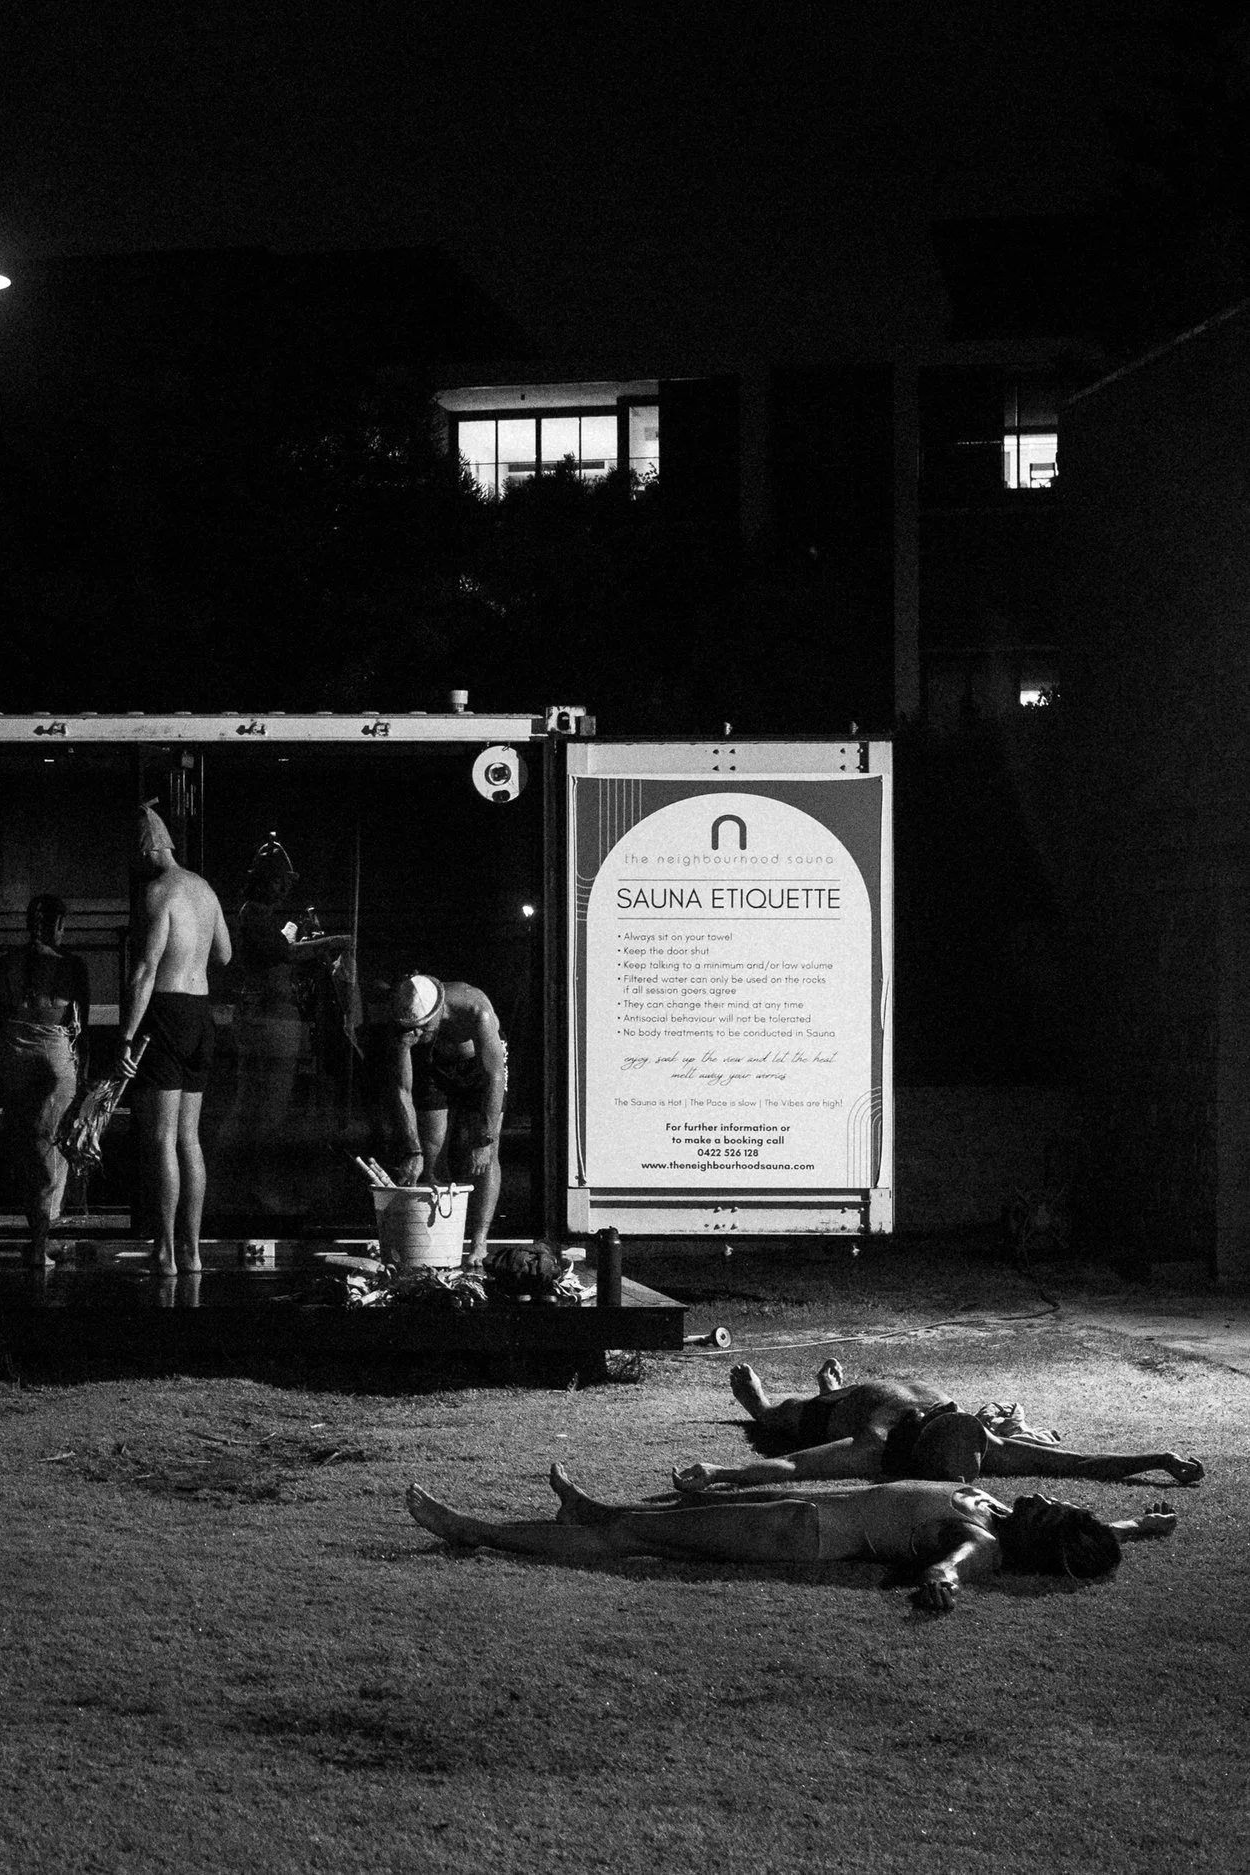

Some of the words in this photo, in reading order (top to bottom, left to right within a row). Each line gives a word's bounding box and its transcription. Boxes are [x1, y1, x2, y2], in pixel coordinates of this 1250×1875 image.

[624, 854, 648, 864] the
[656, 854, 779, 867] neighbourhood
[786, 855, 833, 865] sauna
[616, 888, 702, 909] SAUNA
[711, 888, 840, 909] ETIQUETTE
[623, 932, 655, 943] Always
[657, 933, 668, 942] sit
[670, 934, 682, 942] on
[685, 934, 704, 944] your
[706, 932, 732, 942] towel
[623, 947, 646, 956] Keep
[648, 946, 664, 956] the
[666, 946, 687, 956] door
[690, 946, 709, 956] shut
[623, 961, 646, 970] Keep
[649, 961, 679, 971] talking
[682, 962, 692, 970] to
[694, 962, 700, 970] a
[703, 962, 744, 970] minimum
[746, 961, 779, 971] and/or
[781, 960, 798, 970] low
[800, 961, 833, 970] volume
[623, 975, 658, 986] Filtered
[661, 976, 687, 984] water
[689, 976, 707, 984] can
[709, 976, 728, 985] only
[730, 975, 743, 984] be
[745, 974, 767, 984] used
[770, 976, 782, 984] on
[784, 975, 799, 984] the
[802, 975, 826, 985] rocks
[622, 985, 629, 994] if
[631, 985, 643, 995] all
[645, 987, 678, 995] session
[680, 987, 706, 997] goers
[708, 988, 736, 998] agree
[623, 1000, 644, 1010] They
[646, 1001, 664, 1009] can
[666, 1000, 701, 1011] change
[703, 1000, 724, 1009] their
[727, 1000, 749, 1009] mind
[752, 1001, 762, 1009] at
[764, 1002, 781, 1011] any
[783, 1001, 803, 1009] time
[623, 1013, 668, 1023] Antisocial
[670, 1013, 715, 1023] behaviour
[718, 1013, 733, 1023] will
[736, 1015, 751, 1024] not
[753, 1014, 766, 1024] be
[768, 1014, 811, 1024] tolerated
[622, 1028, 636, 1037] No
[638, 1028, 661, 1038] body
[663, 1029, 713, 1038] treatments
[715, 1029, 725, 1038] to
[728, 1028, 740, 1038] be
[742, 1028, 792, 1038] conducted
[805, 1028, 835, 1038] Sauna
[614, 1097, 628, 1107] The
[630, 1097, 657, 1107] Sauna
[667, 1098, 682, 1107] Hot
[690, 1098, 704, 1107] The
[705, 1098, 727, 1107] Pace
[737, 1099, 756, 1107] slow
[764, 1098, 778, 1108] The
[781, 1099, 804, 1108] Vibes
[822, 1099, 842, 1109] high!
[665, 1122, 681, 1132] For
[683, 1122, 718, 1131] further
[719, 1123, 778, 1132] information
[779, 1125, 790, 1133] or
[671, 1136, 682, 1145] to
[683, 1135, 712, 1144] make
[713, 1137, 721, 1145] a
[723, 1135, 763, 1147] booking
[765, 1136, 784, 1145] call
[696, 1148, 721, 1157] 0422
[723, 1148, 741, 1158] 526
[743, 1148, 759, 1158] 128
[640, 1161, 815, 1172] www.theneighbourhoodsauna.com
